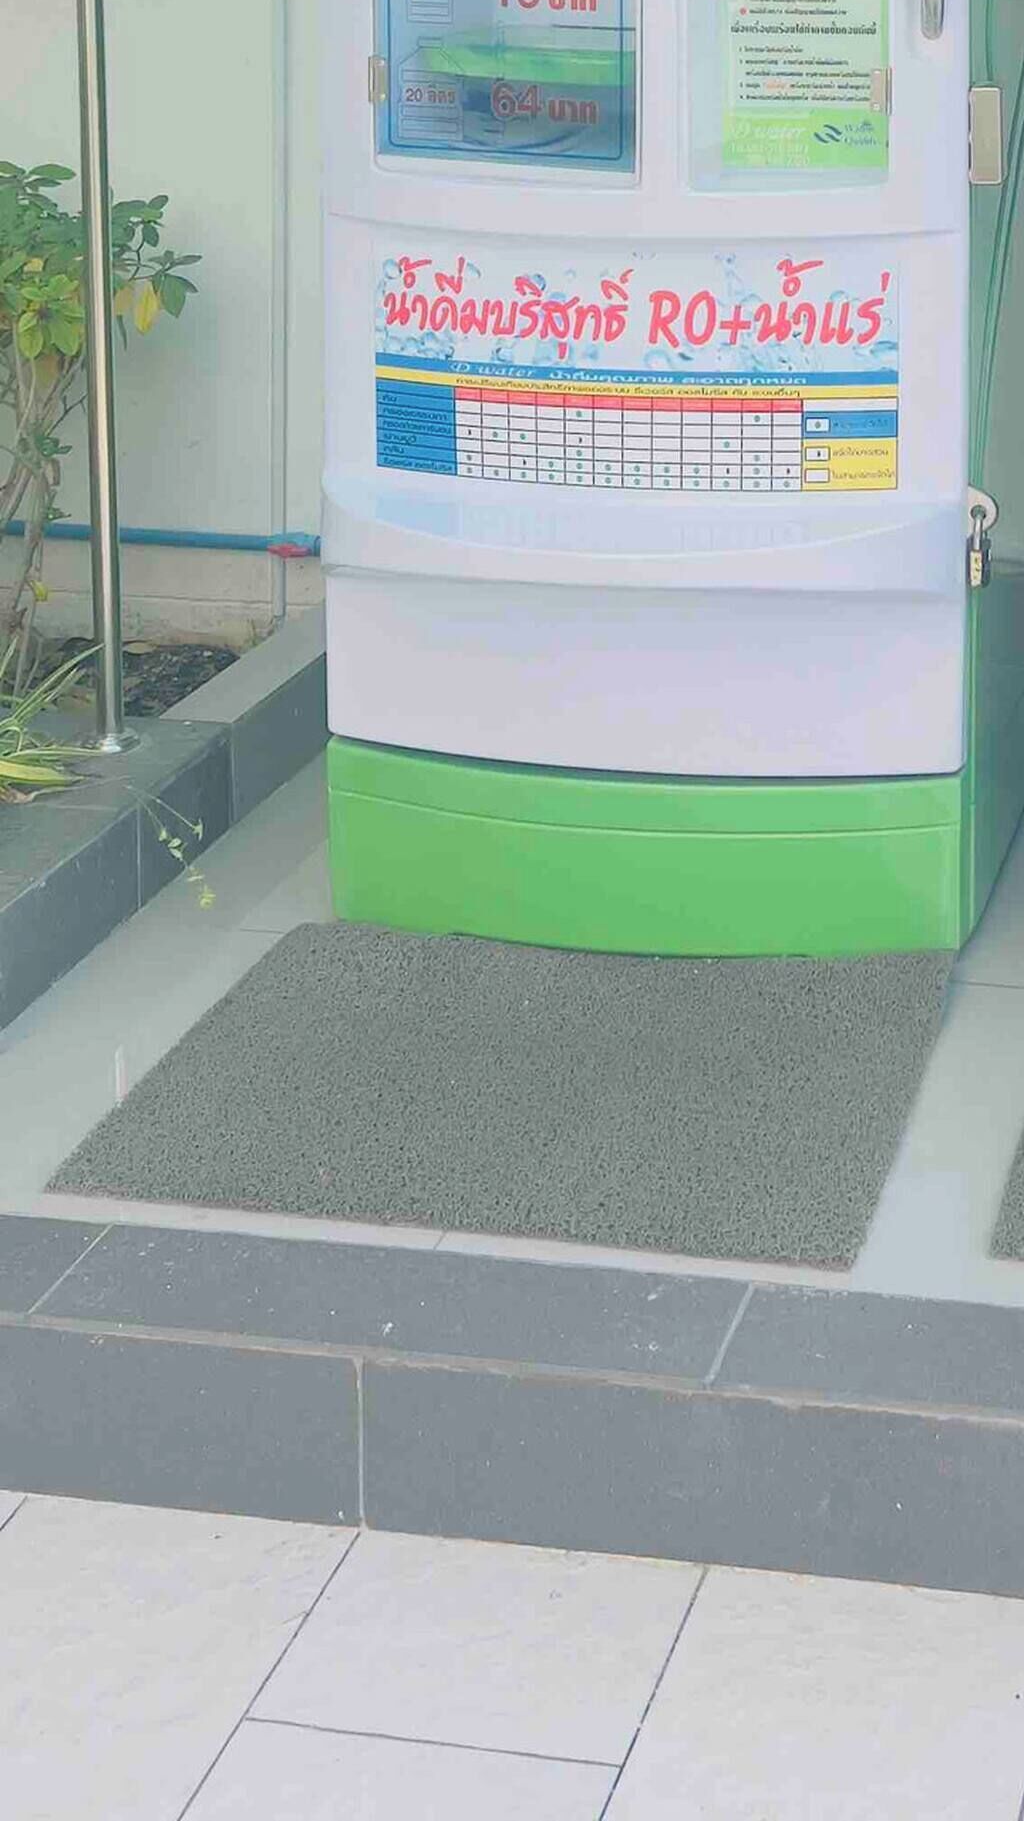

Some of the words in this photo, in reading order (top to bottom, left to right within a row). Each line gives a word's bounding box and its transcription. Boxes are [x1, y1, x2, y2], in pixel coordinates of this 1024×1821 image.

[405, 88, 423, 102] 20
[492, 81, 542, 120] 64
[549, 98, 597, 124] บาท
[384, 256, 634, 360] น้ำดื่มบริสุทธิ์
[649, 259, 891, 348] RO+น้ำแร่
[478, 366, 536, 378] water
